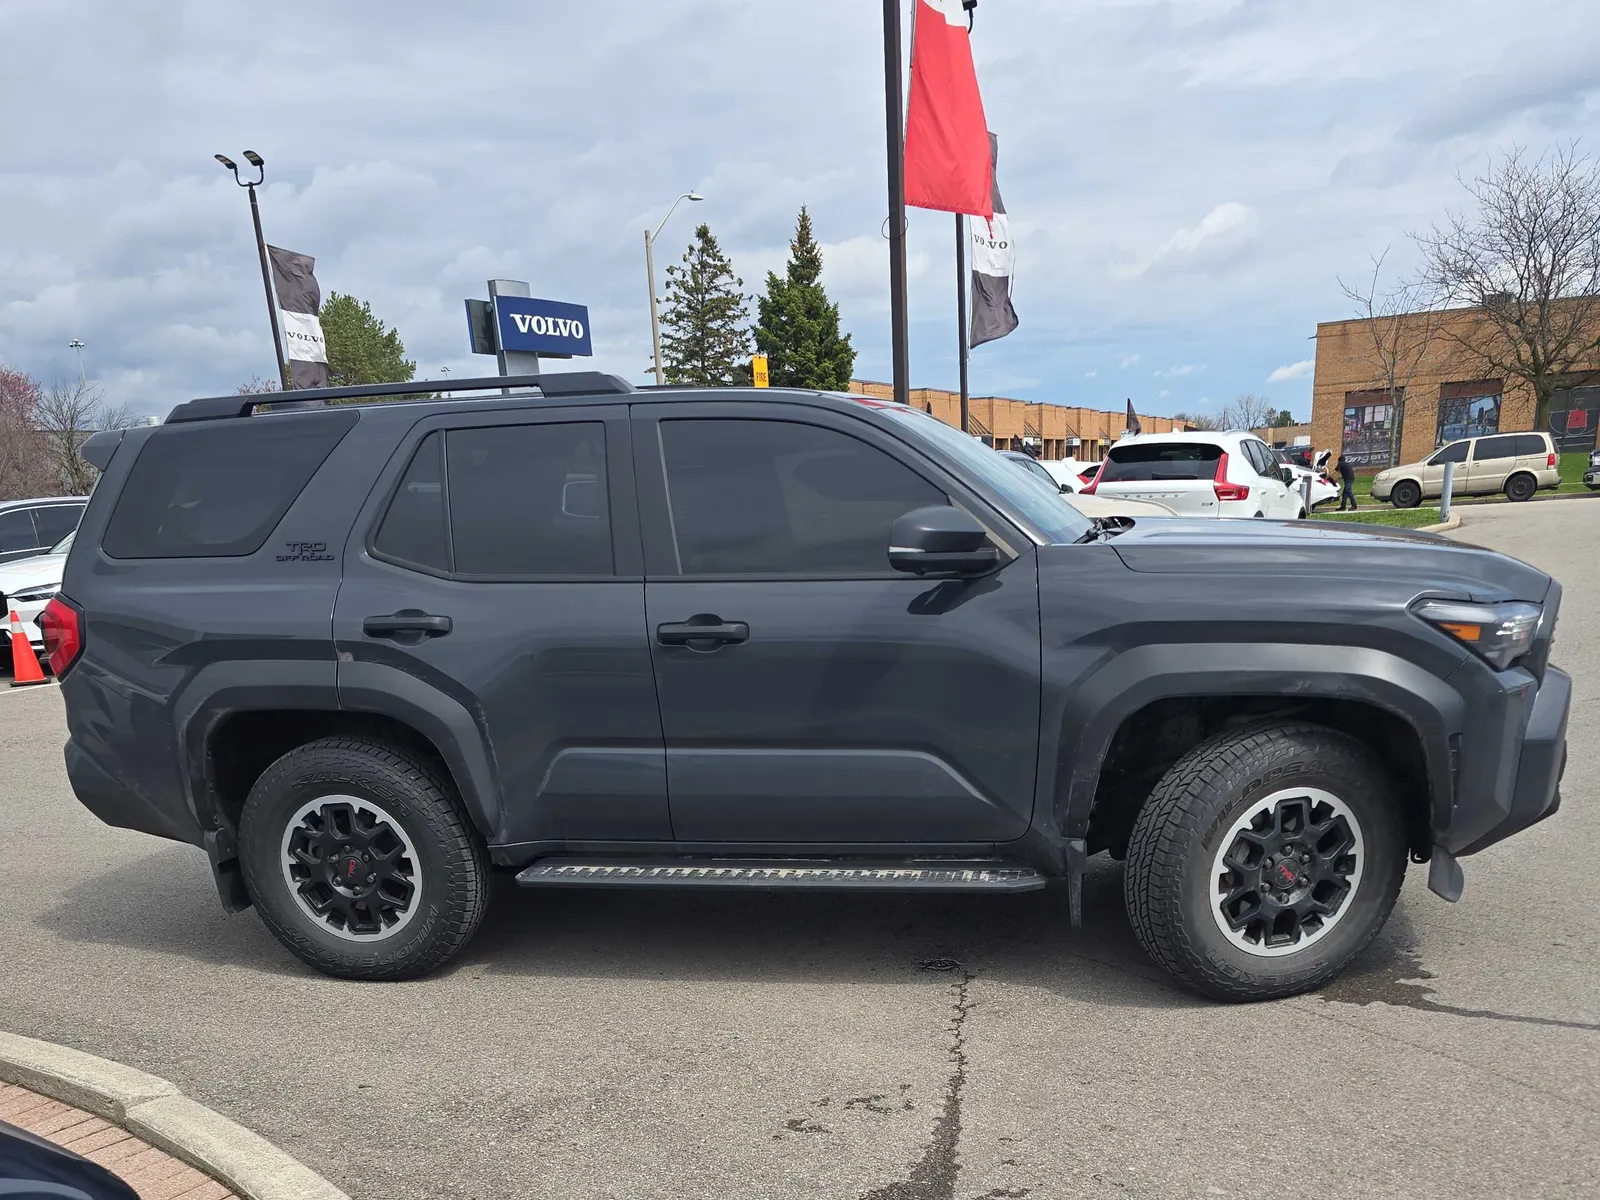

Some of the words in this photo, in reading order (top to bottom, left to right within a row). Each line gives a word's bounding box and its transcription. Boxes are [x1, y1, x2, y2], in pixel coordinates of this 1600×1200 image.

[973, 233, 1008, 249] VOVO
[509, 313, 584, 339] VOLVO
[756, 372, 767, 382] FIRE
[286, 542, 327, 555] TRD
